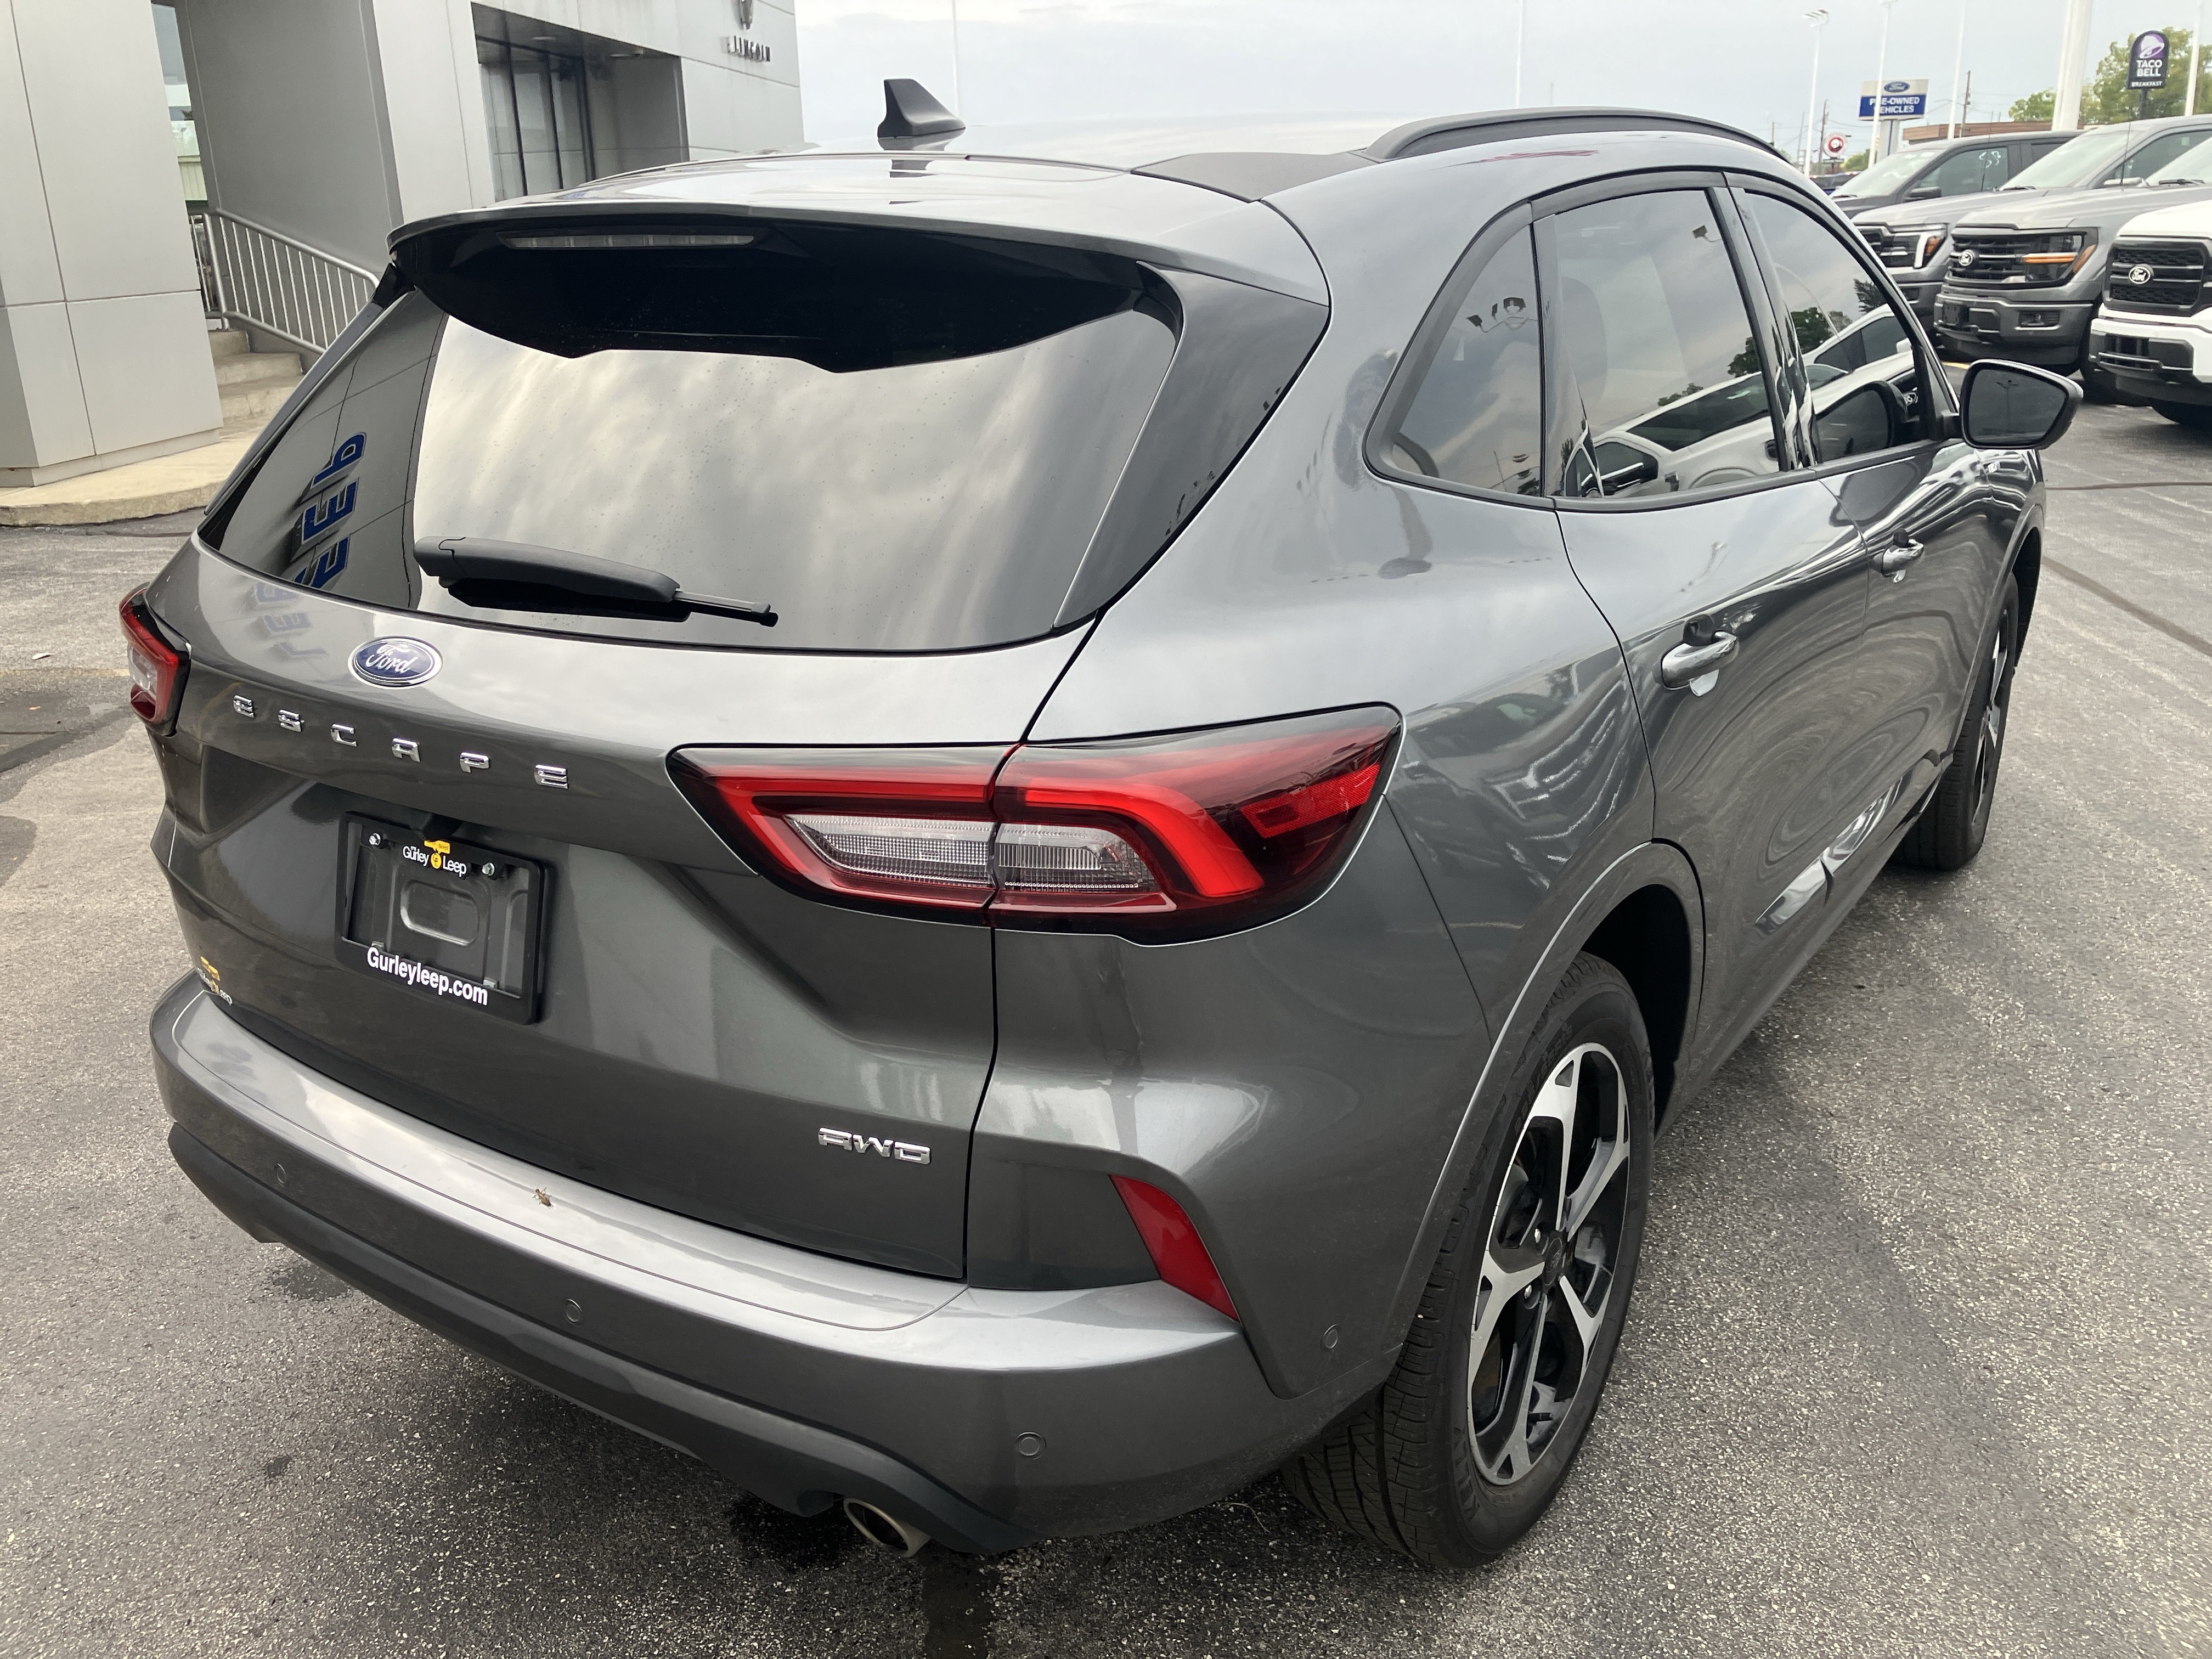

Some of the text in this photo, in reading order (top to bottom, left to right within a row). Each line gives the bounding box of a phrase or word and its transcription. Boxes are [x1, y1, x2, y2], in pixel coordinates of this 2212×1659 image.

[2136, 59, 2163, 67] TACO
[2137, 68, 2161, 77] BELL
[1869, 97, 1920, 105] PE-OWNED
[1880, 105, 1915, 114] EHICLES
[365, 644, 419, 674] Ford
[233, 695, 568, 789] ESCAPE
[443, 855, 467, 877] Leep
[367, 946, 488, 1006] Gurleyleep.com
[818, 1127, 931, 1165] AWD
